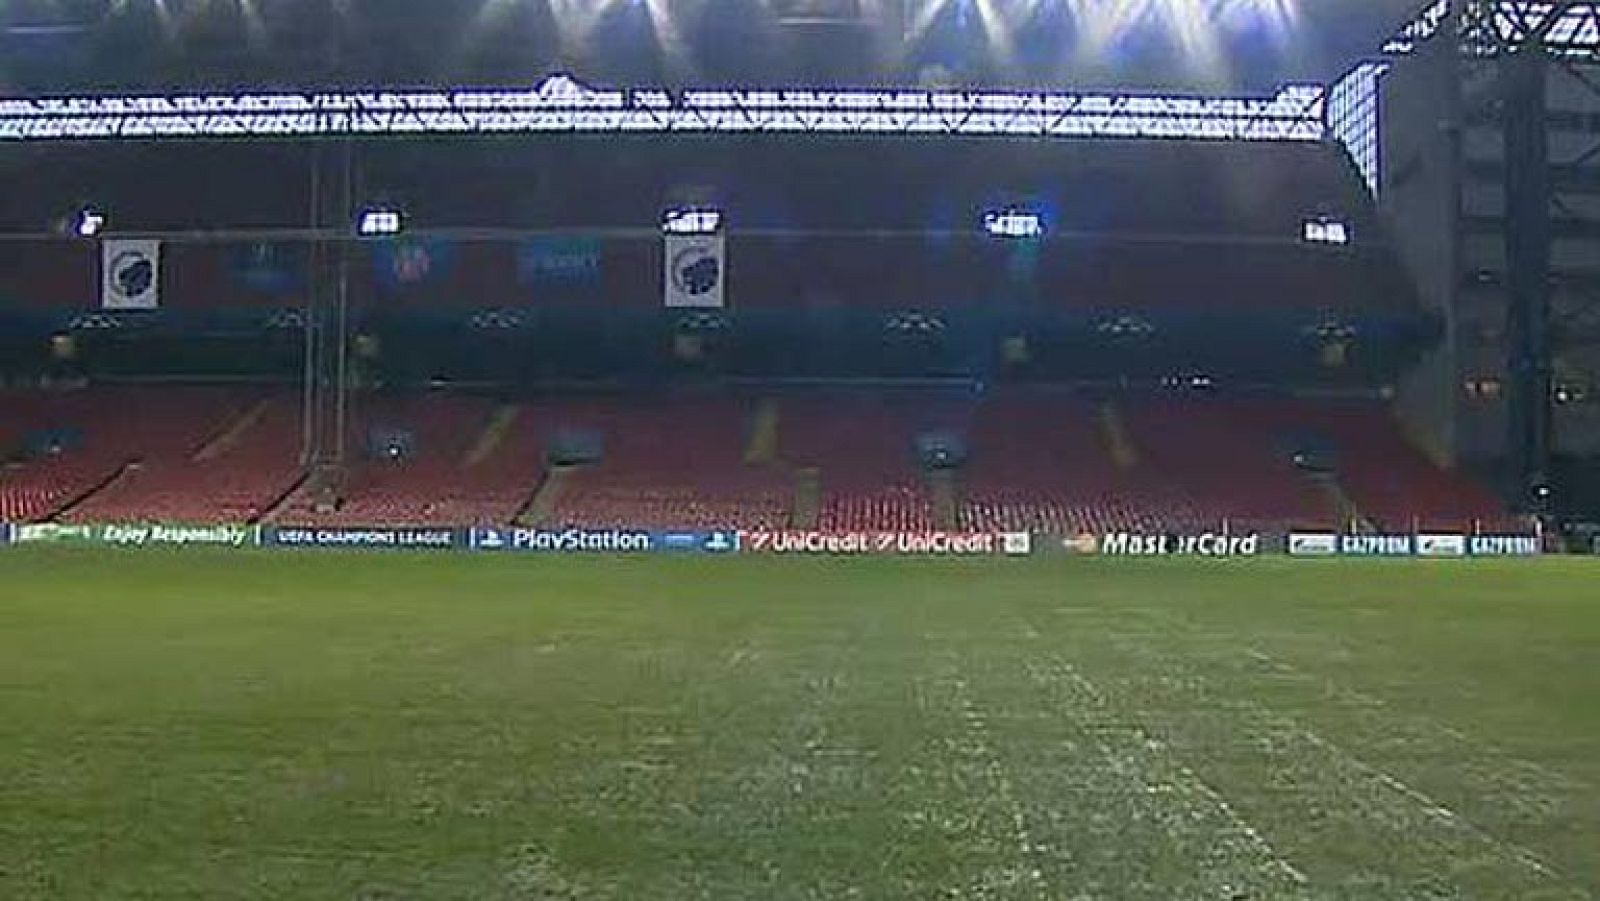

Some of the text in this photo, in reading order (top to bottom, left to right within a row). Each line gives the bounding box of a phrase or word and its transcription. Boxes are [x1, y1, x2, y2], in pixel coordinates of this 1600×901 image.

[513, 529, 650, 550] PlayStation
[772, 531, 868, 551] UniCredit
[898, 531, 994, 551] UniCredit
